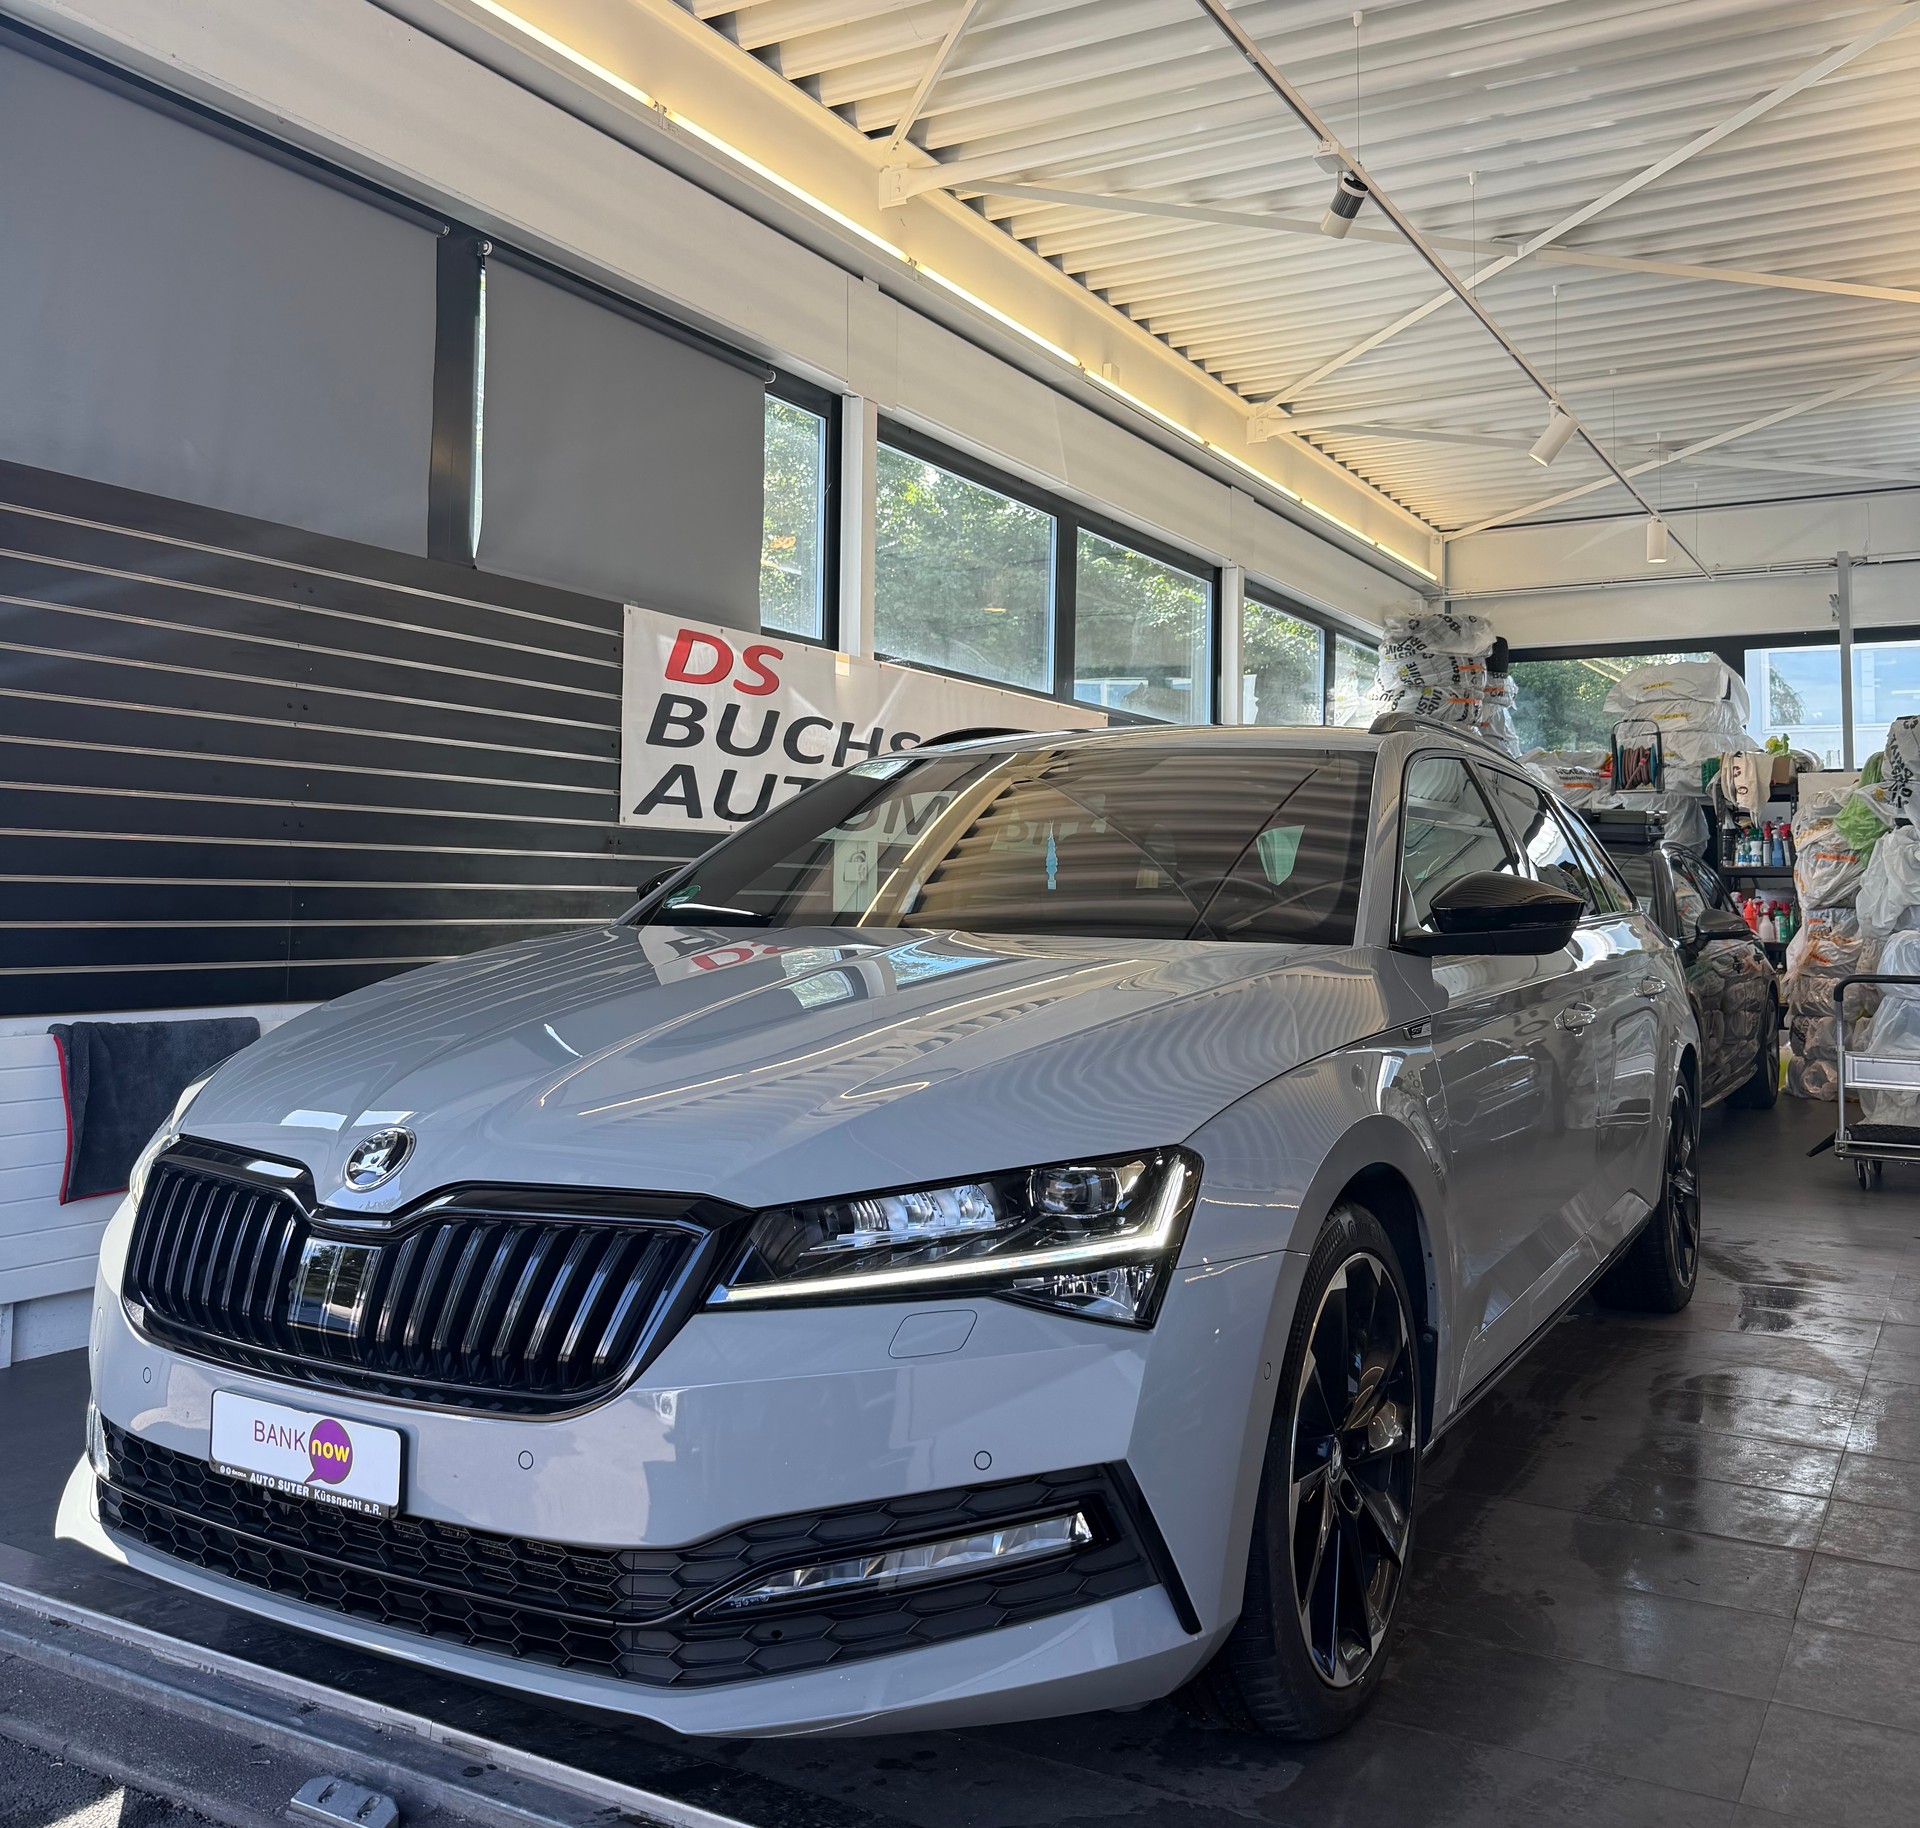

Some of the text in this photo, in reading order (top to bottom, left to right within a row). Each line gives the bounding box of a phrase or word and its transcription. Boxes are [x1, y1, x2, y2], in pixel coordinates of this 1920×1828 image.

[665, 628, 784, 695] DS
[254, 1419, 306, 1453] BANK
[311, 1439, 350, 1463] now
[250, 1472, 275, 1488] AUTO
[278, 1480, 310, 1497] SUTER
[314, 1488, 362, 1511] Küssnacht
